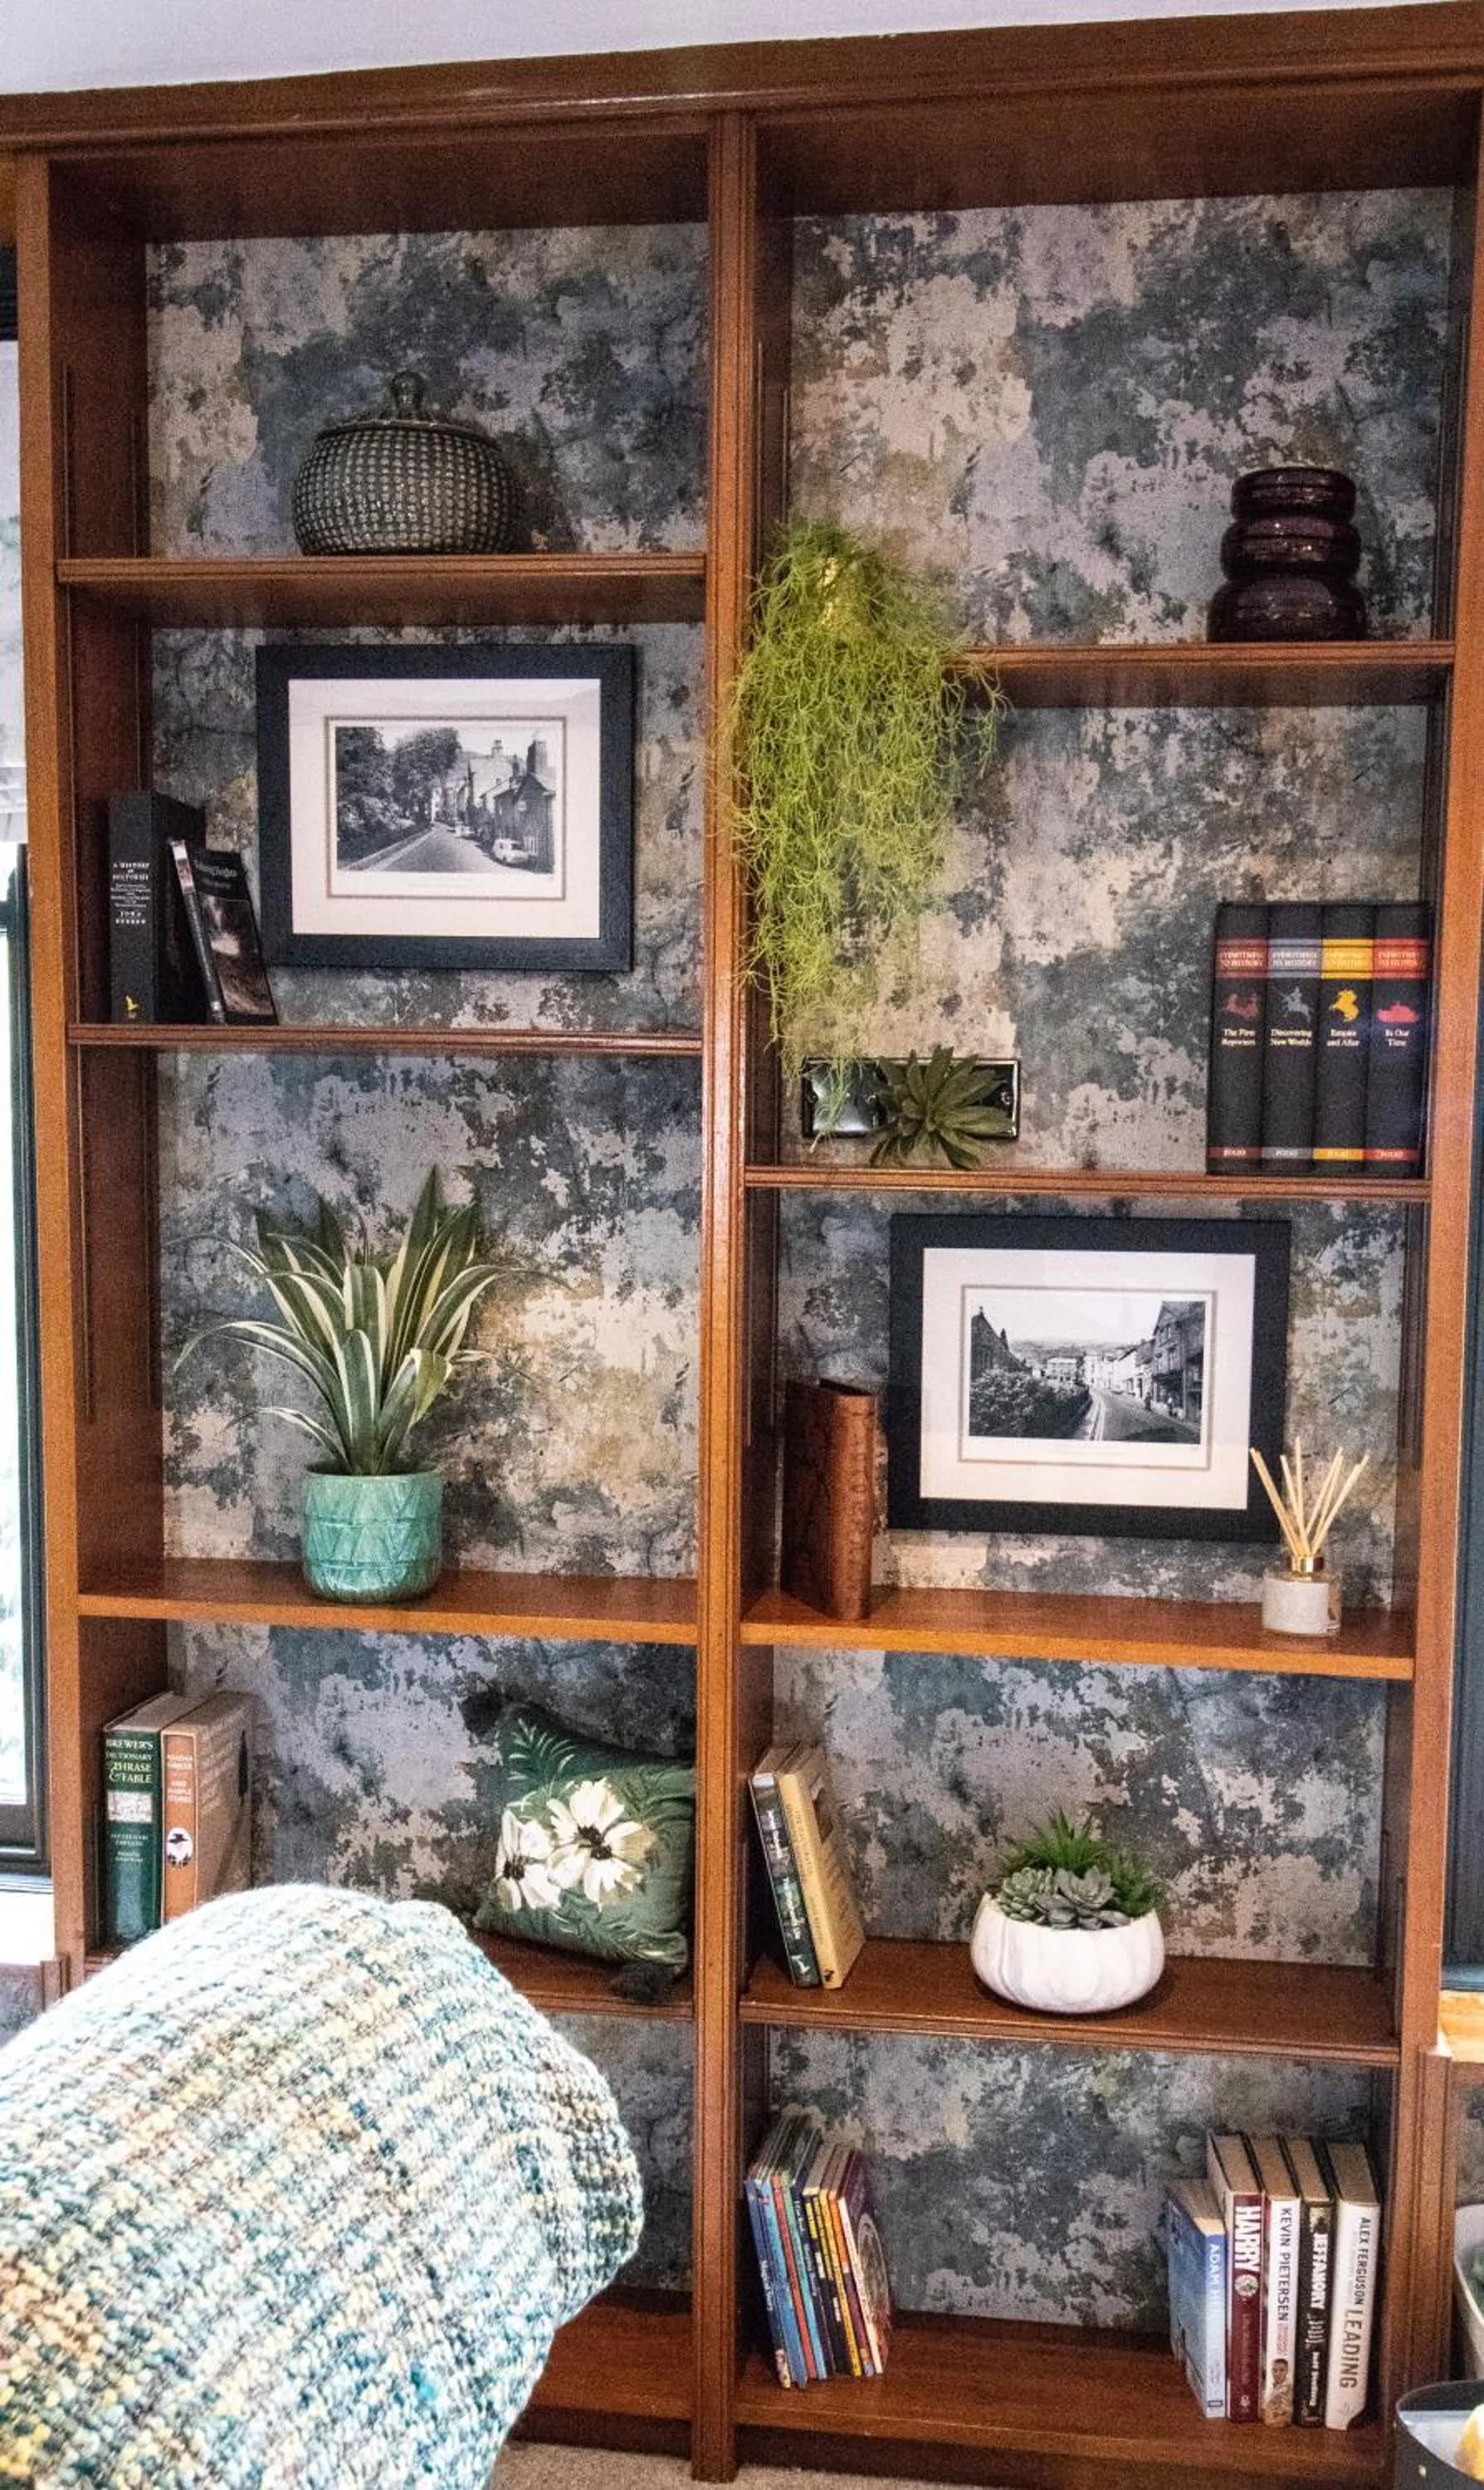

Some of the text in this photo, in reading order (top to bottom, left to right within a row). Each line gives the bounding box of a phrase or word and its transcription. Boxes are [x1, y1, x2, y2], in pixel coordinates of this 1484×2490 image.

[106, 1739, 154, 1750] BREWER'S
[114, 1761, 152, 1773] PHRASE
[121, 1773, 154, 1784] FABLE
[1234, 2205, 1262, 2272] HARRY
[1279, 2207, 1292, 2246] KEVIN
[1209, 2243, 1221, 2285] ADAM
[1354, 2217, 1371, 2306] ALEX FERGUSON
[1277, 2252, 1291, 2321] PIETERSEN
[1340, 2310, 1364, 2389] LEADING
